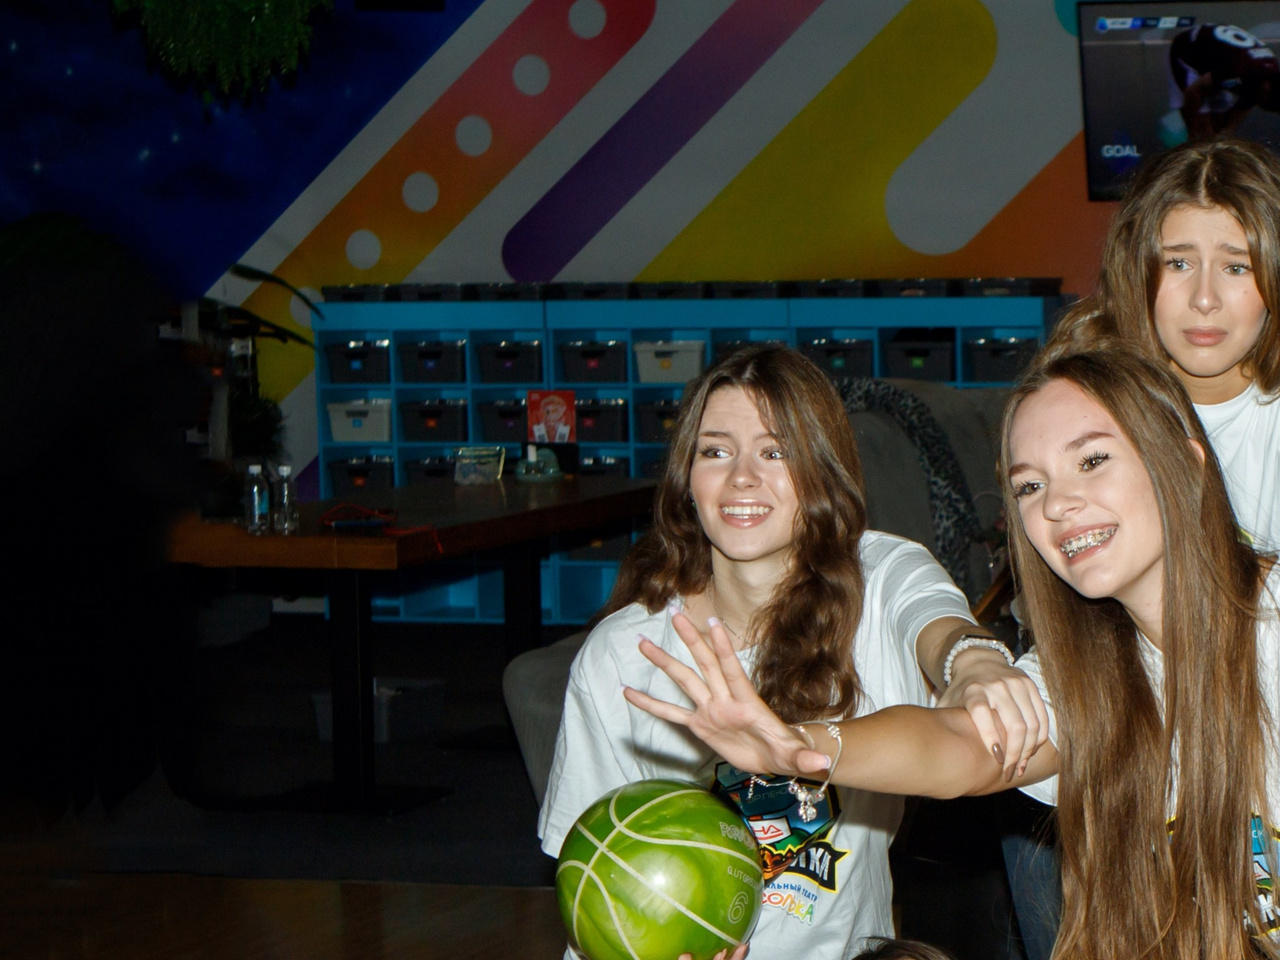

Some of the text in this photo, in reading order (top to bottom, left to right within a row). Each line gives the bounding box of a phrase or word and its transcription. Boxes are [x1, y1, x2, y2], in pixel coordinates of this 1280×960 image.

[1101, 144, 1142, 157] GOAL
[801, 888, 818, 902] ТЕАТР
[727, 891, 749, 924] 6
